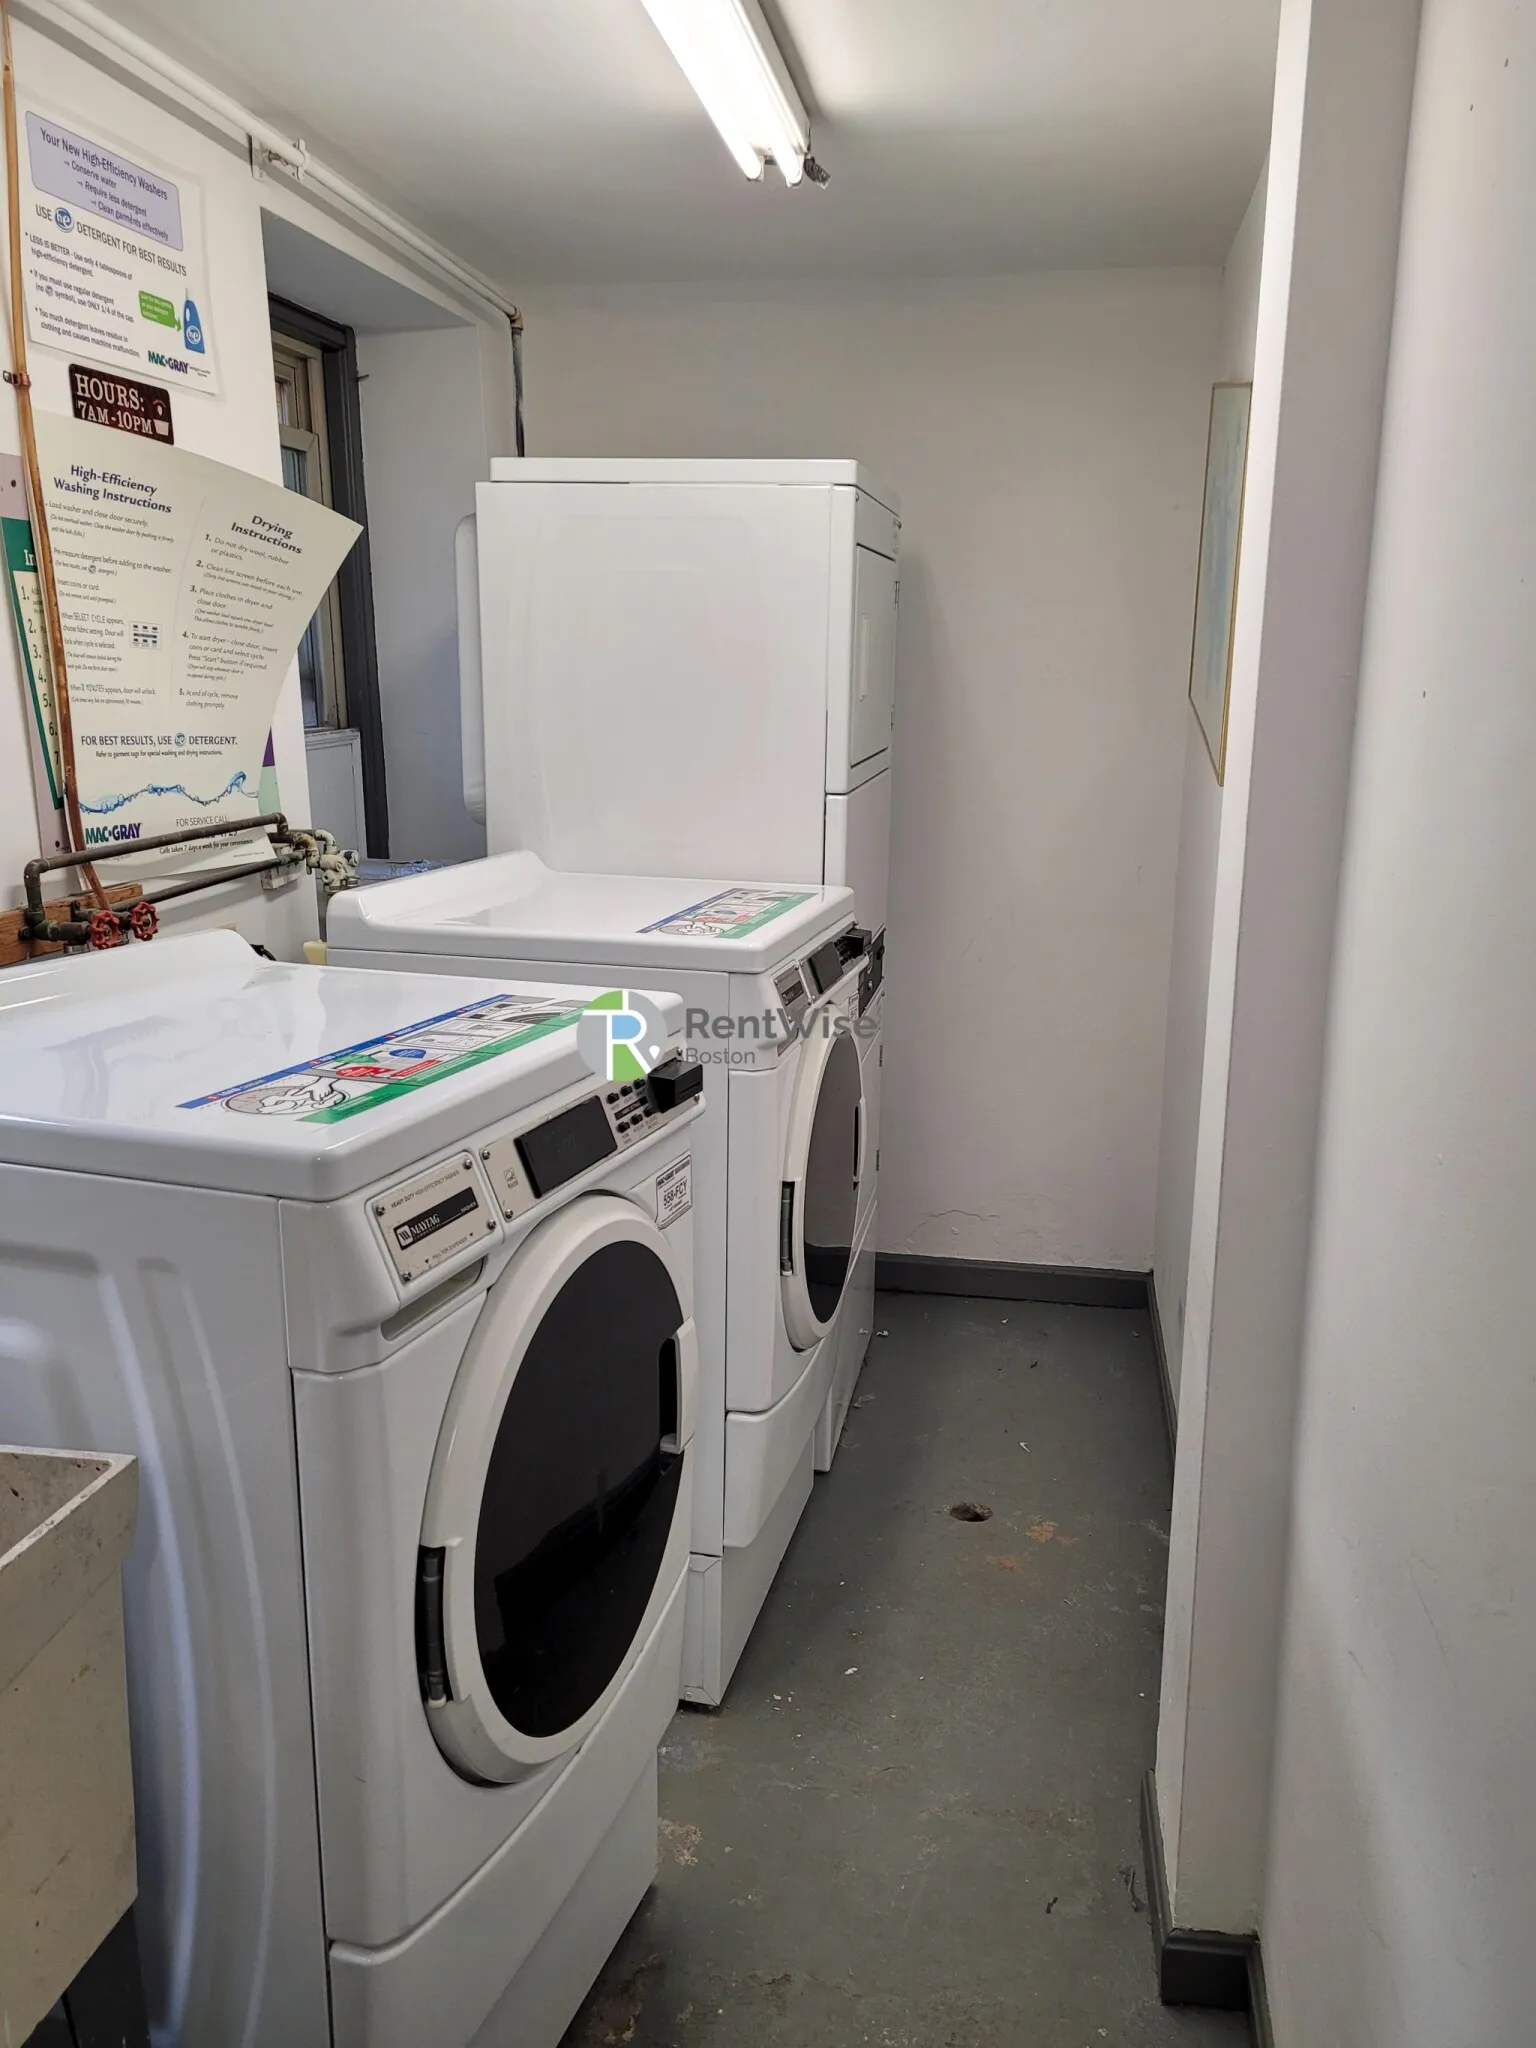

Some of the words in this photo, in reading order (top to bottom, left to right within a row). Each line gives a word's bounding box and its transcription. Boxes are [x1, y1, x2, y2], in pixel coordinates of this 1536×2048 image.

[40, 128, 59, 148] Your
[62, 138, 80, 158] New
[82, 149, 137, 188] High-Efficiency
[138, 176, 168, 201] Washers
[72, 160, 99, 181] Conserve
[100, 173, 116, 189] water
[84, 180, 108, 201] Require
[108, 191, 120, 205] less
[121, 197, 147, 219] detergent
[98, 200, 114, 216] Clean
[115, 208, 141, 230] garments
[142, 220, 168, 242] effectively
[36, 204, 52, 222] USE
[77, 222, 121, 250] DETERGENT
[122, 240, 137, 257] FOR
[138, 247, 156, 264] BEST
[158, 255, 187, 277] RESULTS
[76, 373, 145, 412] HOURS:
[70, 465, 158, 496] High-Efficiency
[54, 477, 100, 501] Washing
[103, 488, 172, 514] Instructions
[49, 499, 61, 509] Load
[62, 502, 81, 513] washer
[82, 506, 93, 516] and
[94, 509, 108, 519] close
[109, 512, 123, 522] door
[231, 522, 302, 554] Instructions
[252, 515, 294, 540] Drying
[54, 548, 80, 558] Pre-measure
[80, 553, 102, 564] detergent
[102, 556, 118, 565] before
[119, 559, 136, 569] adding
[214, 537, 225, 545] Do
[225, 540, 237, 549] not
[237, 544, 248, 554] dry
[267, 554, 290, 565] rubber
[196, 560, 205, 568] 2.
[206, 562, 224, 573] Clean
[224, 568, 235, 576] lint
[236, 573, 255, 582] screen
[255, 577, 276, 588] before
[276, 582, 291, 592] each
[21, 586, 29, 600] 1.
[199, 587, 216, 596] Place
[215, 591, 237, 602] clothes
[244, 598, 260, 609] dryer
[260, 602, 273, 610] and
[28, 618, 36, 633] 2.
[33, 644, 41, 658] 3.
[198, 634, 211, 642] start
[211, 636, 226, 646] dryer
[230, 639, 245, 648] close
[261, 645, 279, 653] insert
[220, 658, 239, 666] button
[38, 669, 46, 683] 4.
[43, 694, 51, 707] 5.
[49, 722, 57, 736] 6.
[81, 736, 97, 745] FOR
[100, 736, 118, 745] BEST
[122, 736, 156, 746] RESULTS,
[159, 736, 172, 745] USE
[189, 736, 238, 745] DETERGENT.
[147, 750, 160, 758] special
[176, 818, 189, 827] FOR
[190, 817, 213, 826] SERVICE
[390, 1198, 404, 1208] HEAVY
[404, 1192, 415, 1202] DUTY
[411, 1214, 440, 1236] MAYTAG
